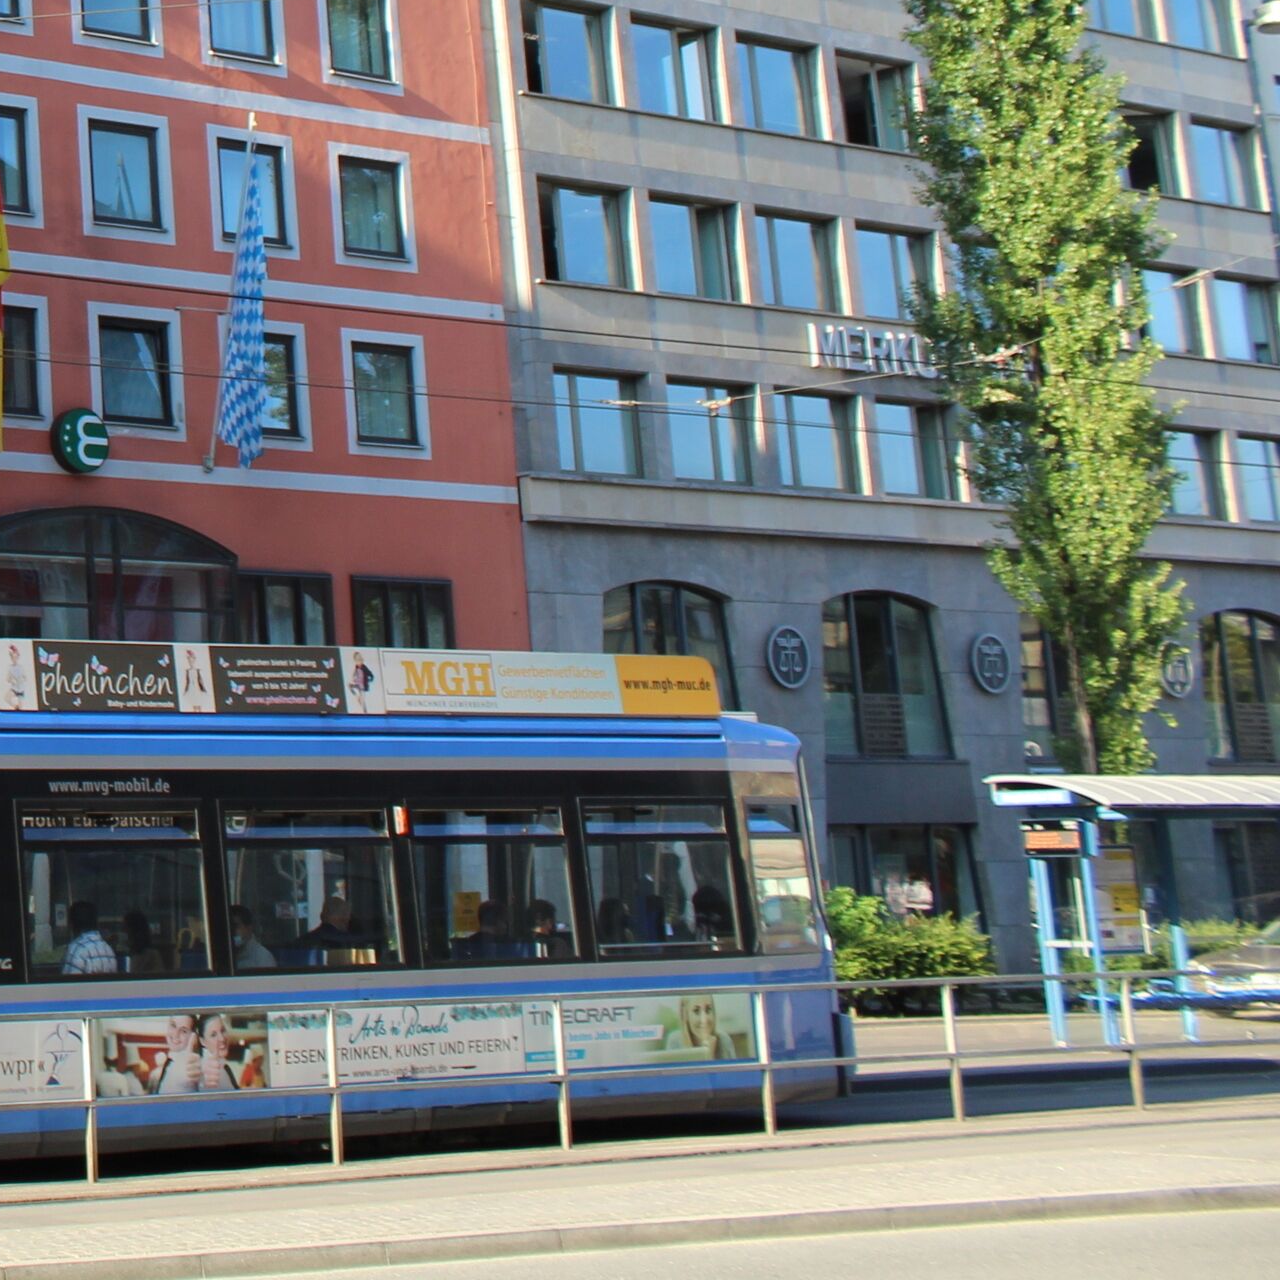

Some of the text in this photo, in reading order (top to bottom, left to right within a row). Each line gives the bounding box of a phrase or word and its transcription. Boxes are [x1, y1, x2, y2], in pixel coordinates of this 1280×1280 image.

[807, 322, 939, 380] MERKU
[40, 663, 174, 706] phelinchen
[401, 660, 497, 698] MGH
[623, 678, 712, 694] www.mgh-muc.de
[245, 695, 318, 706] www.phelinchen.de
[500, 685, 615, 702] Günstige Konditionen
[48, 777, 171, 796] www.mvg-mobil.de
[284, 1049, 327, 1065] ESSEN
[395, 1042, 436, 1058] KUNST
[439, 1040, 466, 1055] UND
[468, 1037, 512, 1054] FEIERN
